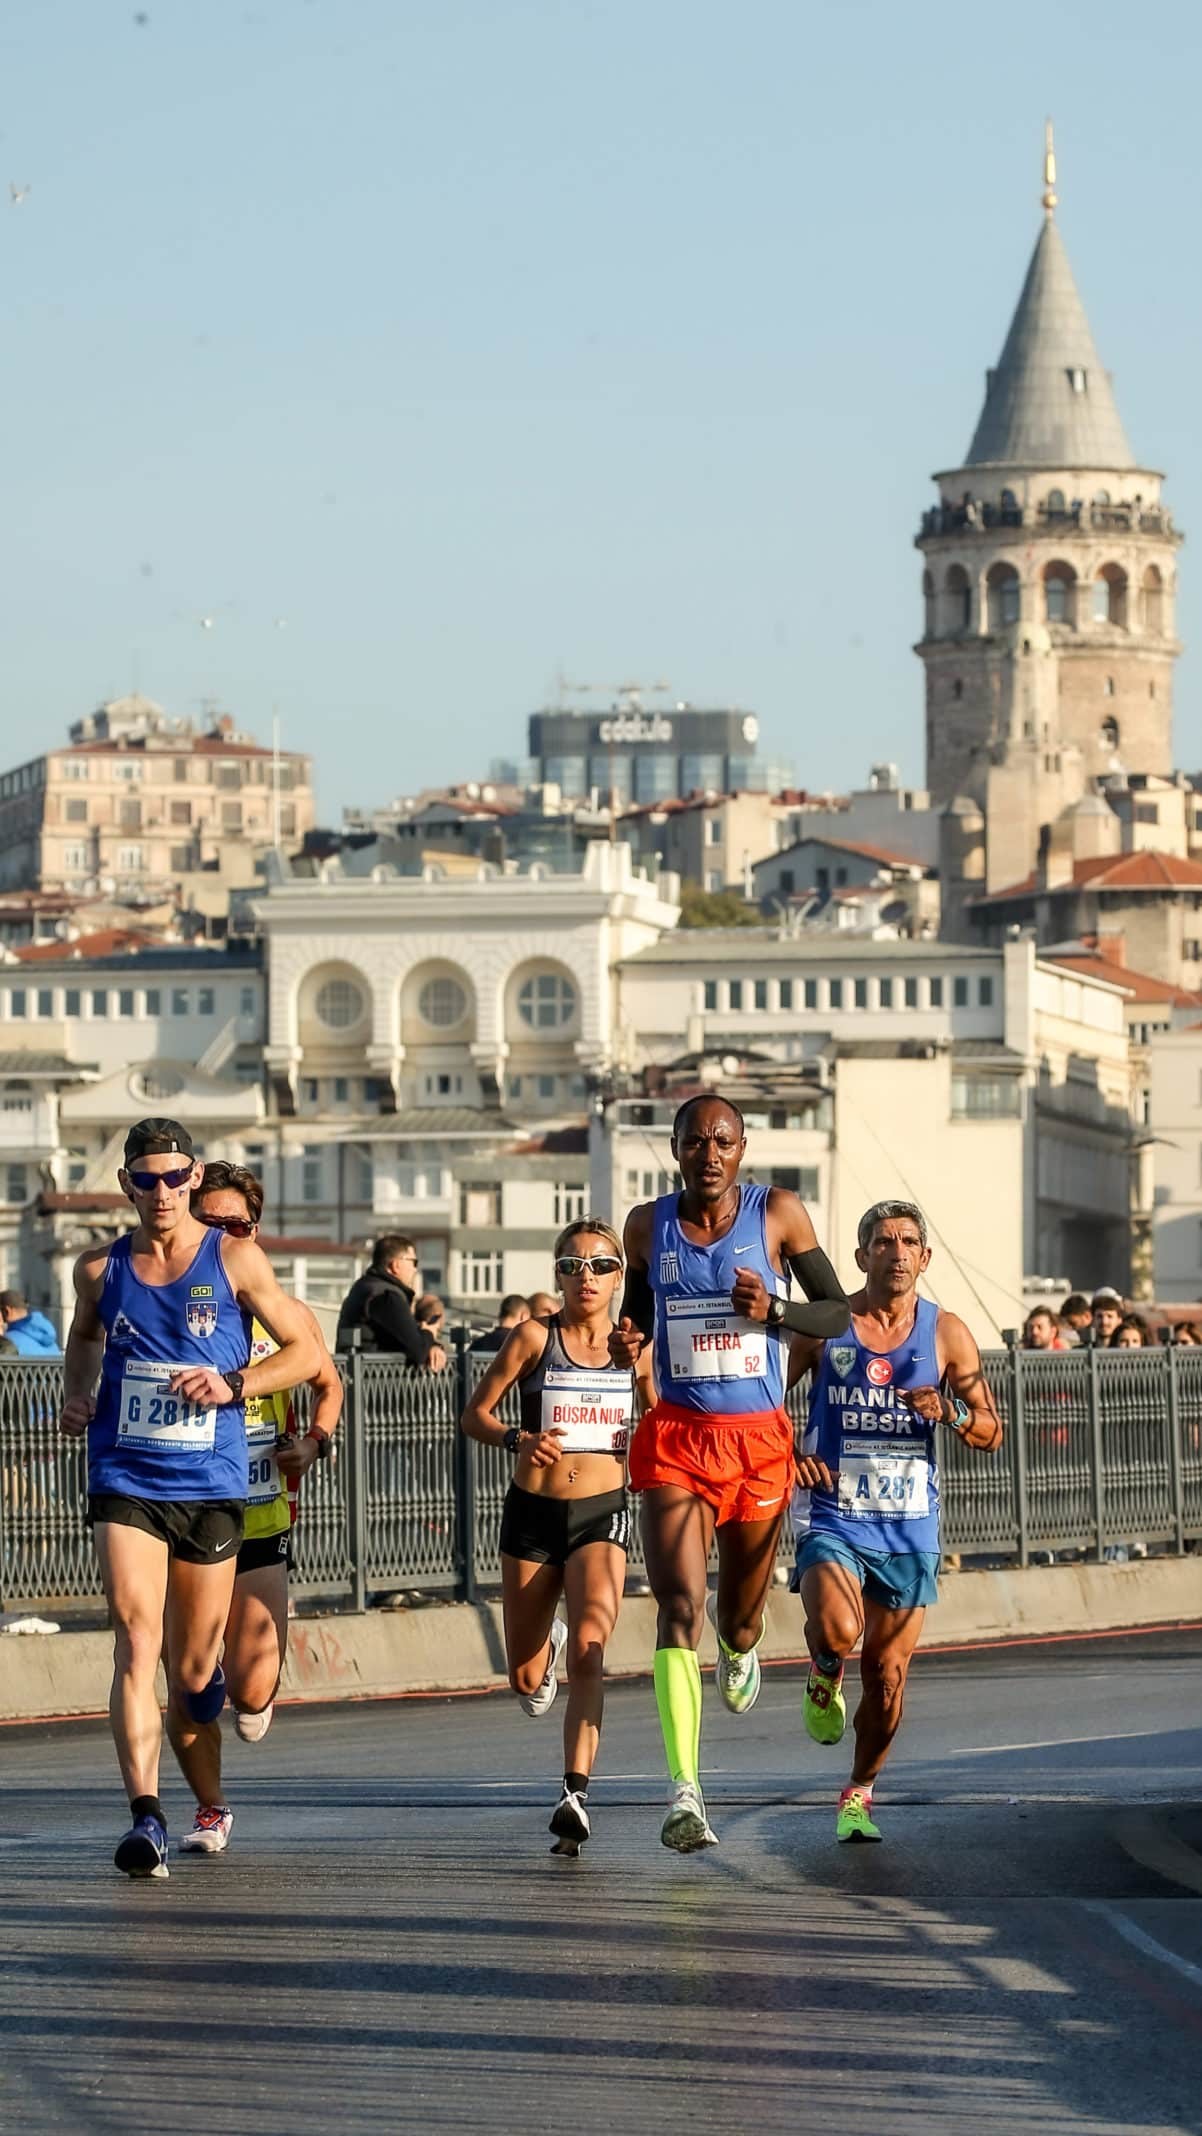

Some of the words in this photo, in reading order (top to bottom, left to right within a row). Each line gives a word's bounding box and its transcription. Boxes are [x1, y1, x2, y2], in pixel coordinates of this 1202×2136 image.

[191, 1286, 212, 1296] GO!
[692, 1332, 741, 1352] TEFERA
[744, 1355, 760, 1373] 52
[128, 1395, 141, 1422] G
[553, 1404, 597, 1425] BÜŞRA
[600, 1407, 624, 1424] NUR
[842, 1411, 912, 1434] BBSK
[856, 1474, 870, 1499] A
